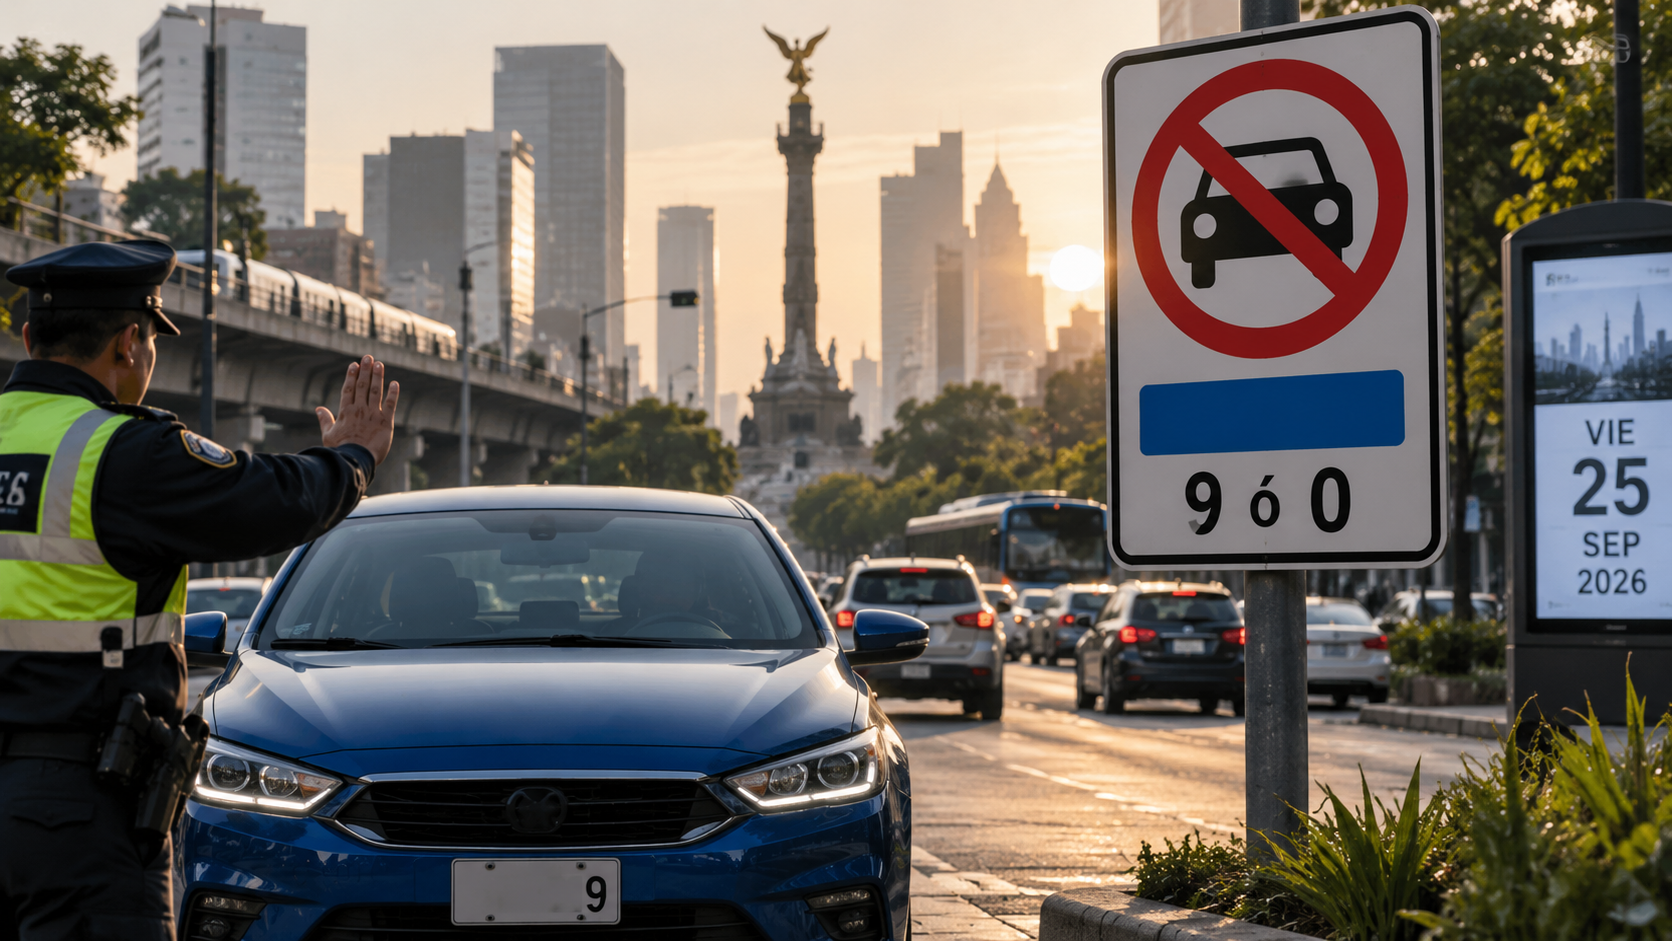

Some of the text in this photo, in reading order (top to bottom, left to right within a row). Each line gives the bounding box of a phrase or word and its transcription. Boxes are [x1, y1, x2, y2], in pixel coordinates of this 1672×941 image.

[1585, 419, 1635, 446] VIE
[1185, 467, 1351, 535] 9 ó 0
[1573, 457, 1649, 516] 25
[1583, 531, 1640, 557] SEP
[1578, 568, 1647, 595] 2026
[586, 875, 607, 913] 9
